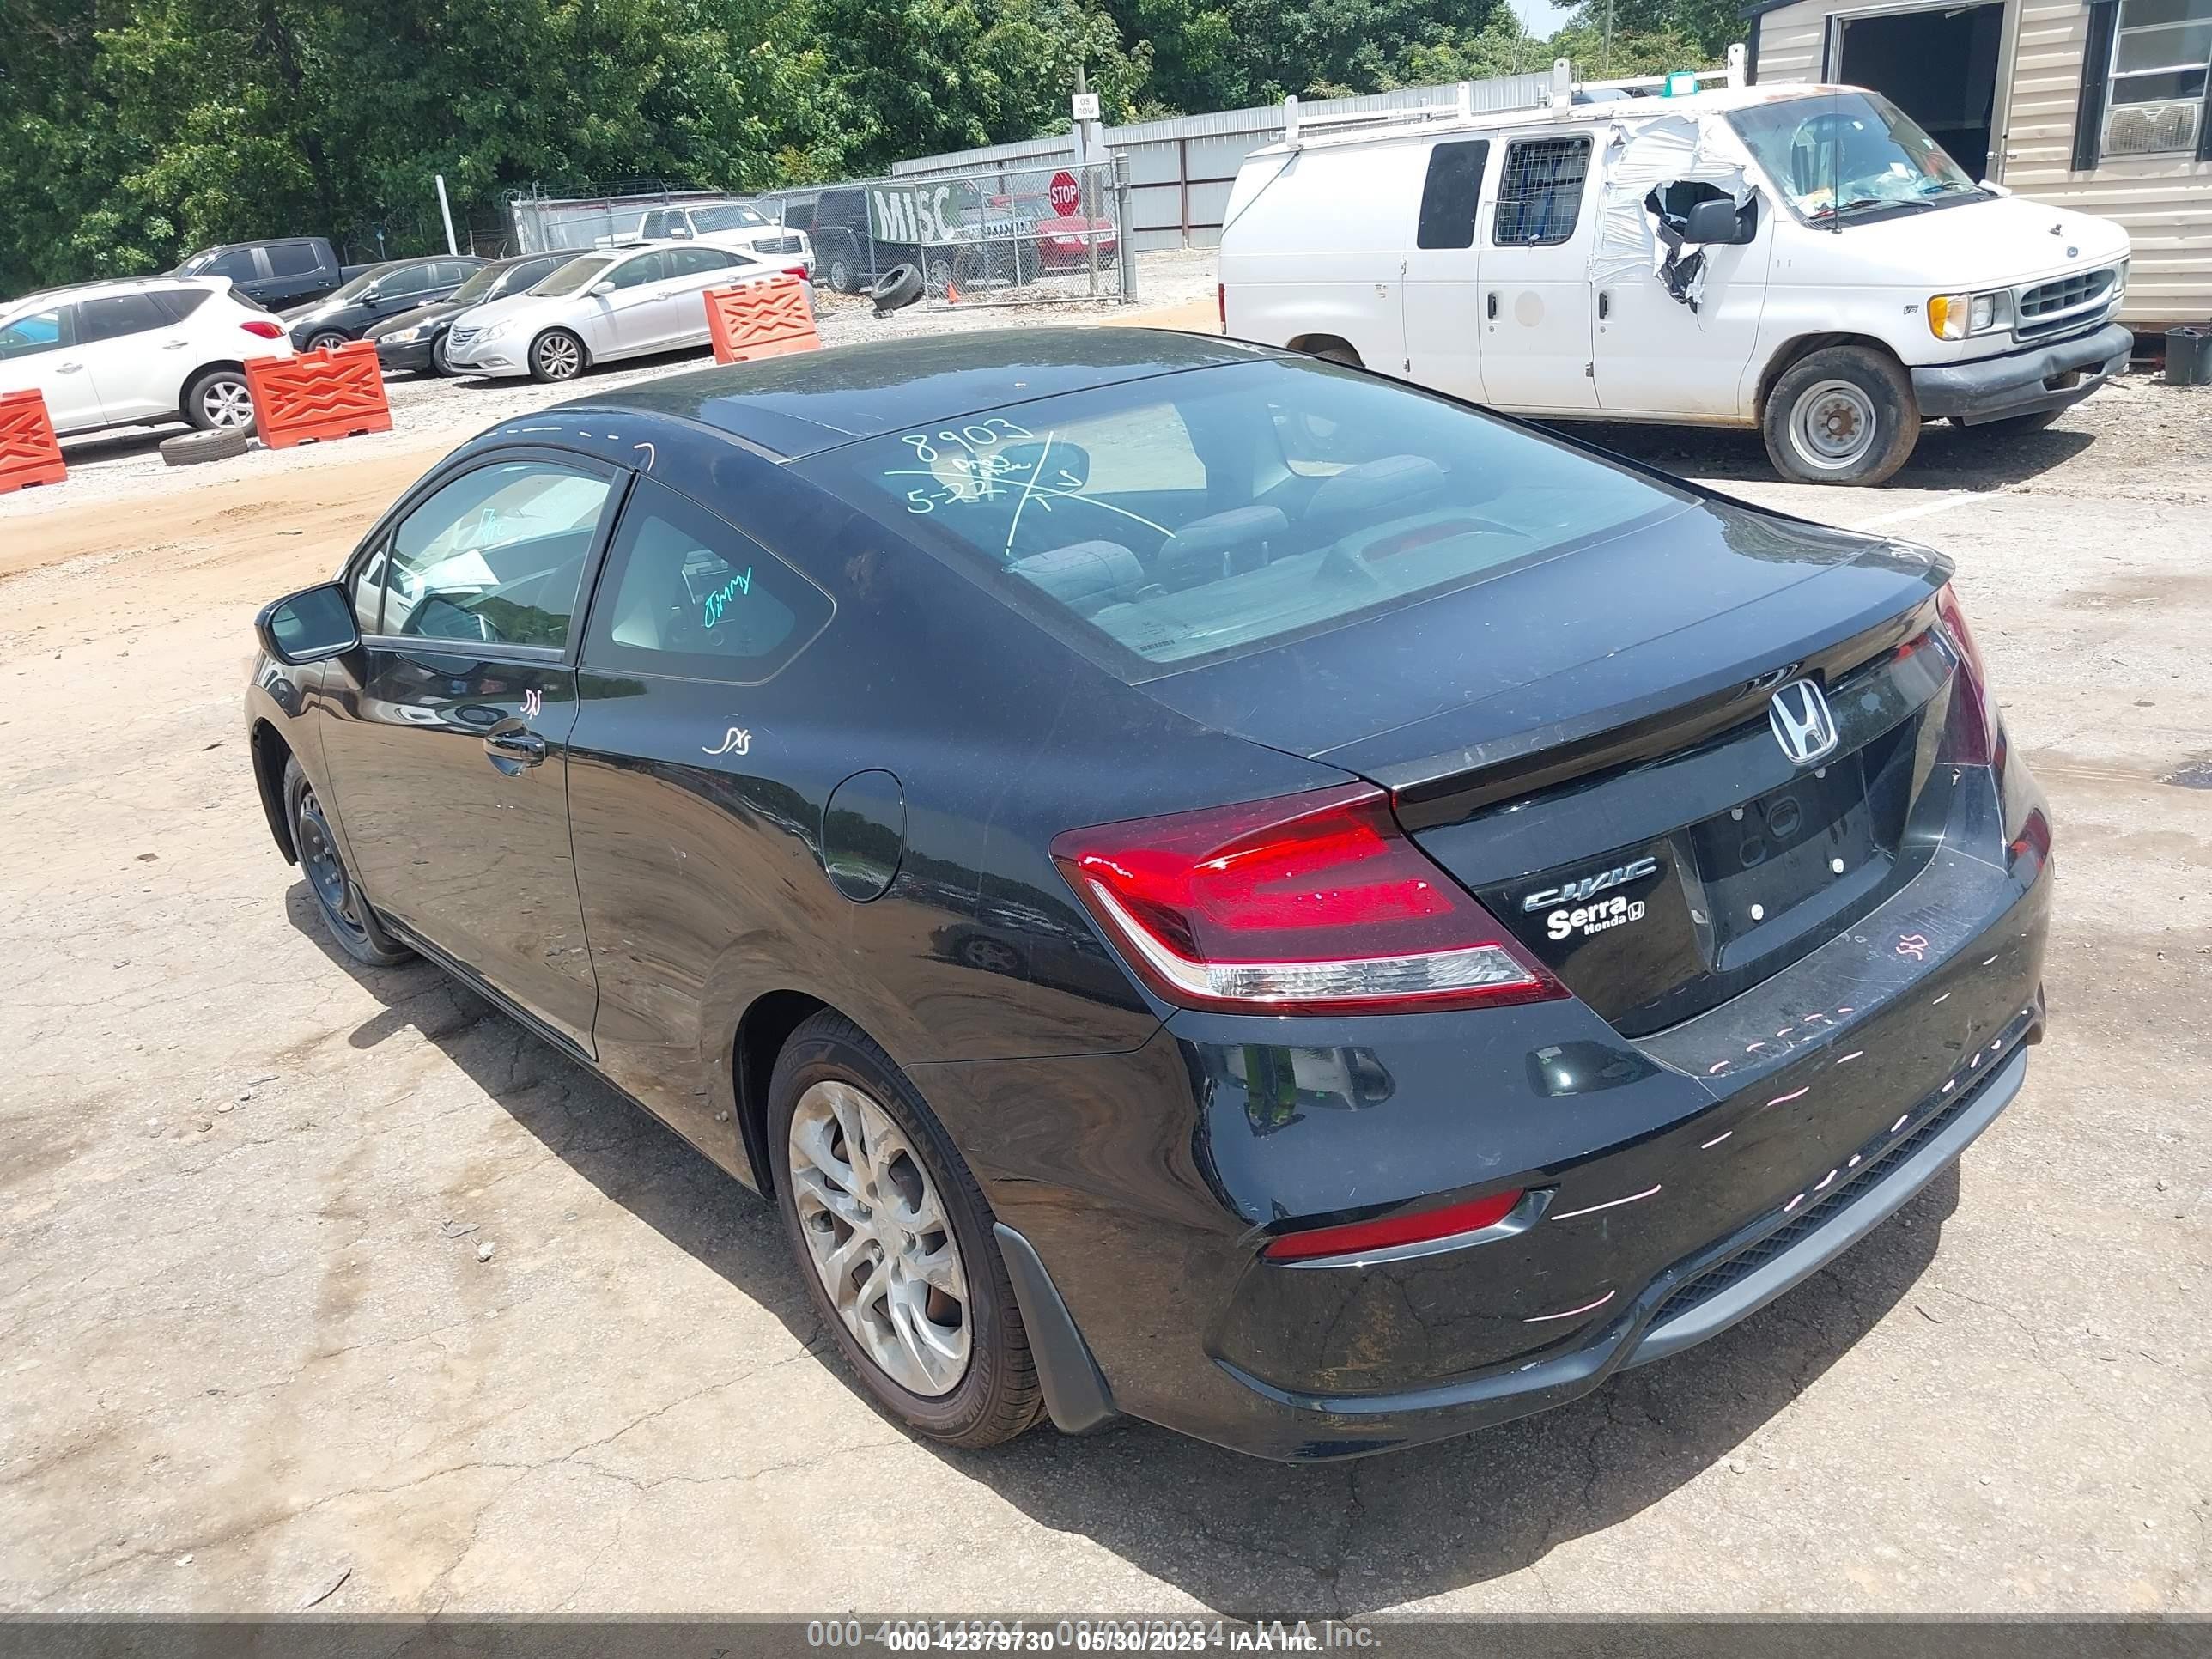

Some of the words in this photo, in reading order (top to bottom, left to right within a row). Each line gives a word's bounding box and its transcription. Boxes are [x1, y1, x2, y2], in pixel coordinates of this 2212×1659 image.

[1078, 107, 1095, 116] ROW
[873, 186, 955, 241] MISC
[1051, 185, 1077, 204] STOP
[902, 418, 1035, 463] 8903
[1523, 856, 1658, 914] CIVIC
[1547, 896, 1627, 941] Serra
[1583, 915, 1627, 936] Honda
